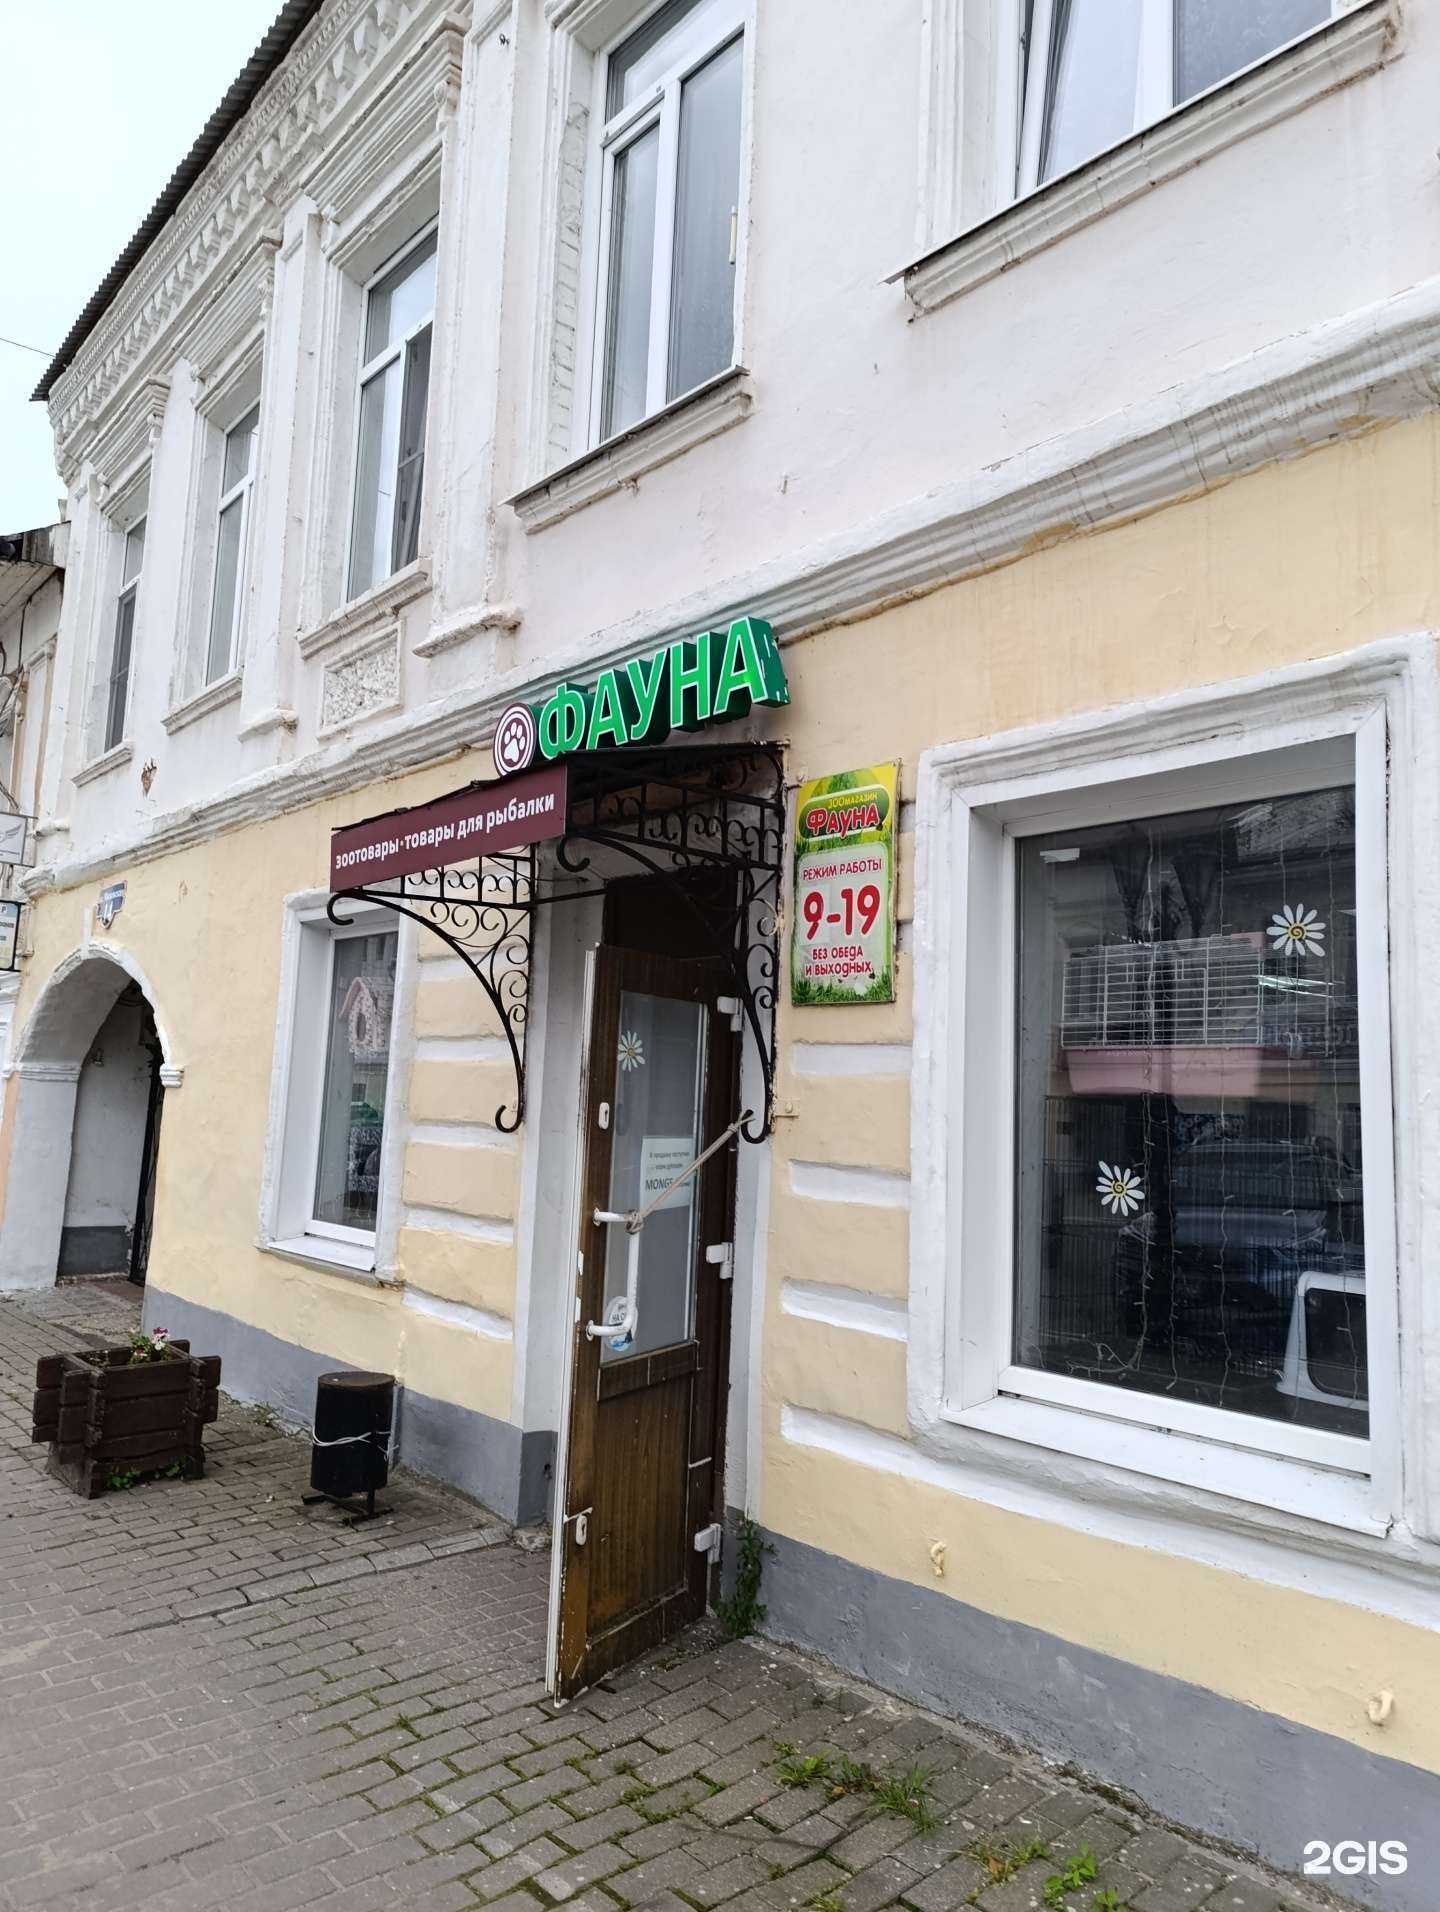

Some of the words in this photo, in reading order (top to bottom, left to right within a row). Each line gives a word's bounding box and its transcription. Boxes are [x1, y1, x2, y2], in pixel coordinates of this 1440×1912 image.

[538, 616, 770, 759] ФАУНА
[457, 813, 483, 840] для
[486, 793, 555, 833] рыбалки
[806, 803, 880, 839] ФАУНА
[803, 863, 838, 881] РЕЖИМ
[839, 858, 882, 875] РАБОТЫ
[803, 884, 881, 941] 9-19
[805, 964, 812, 977] И
[814, 961, 872, 978] ВЫХОДНЫХ
[812, 947, 828, 961] БЕЗ
[831, 945, 864, 962] ОБЕДА
